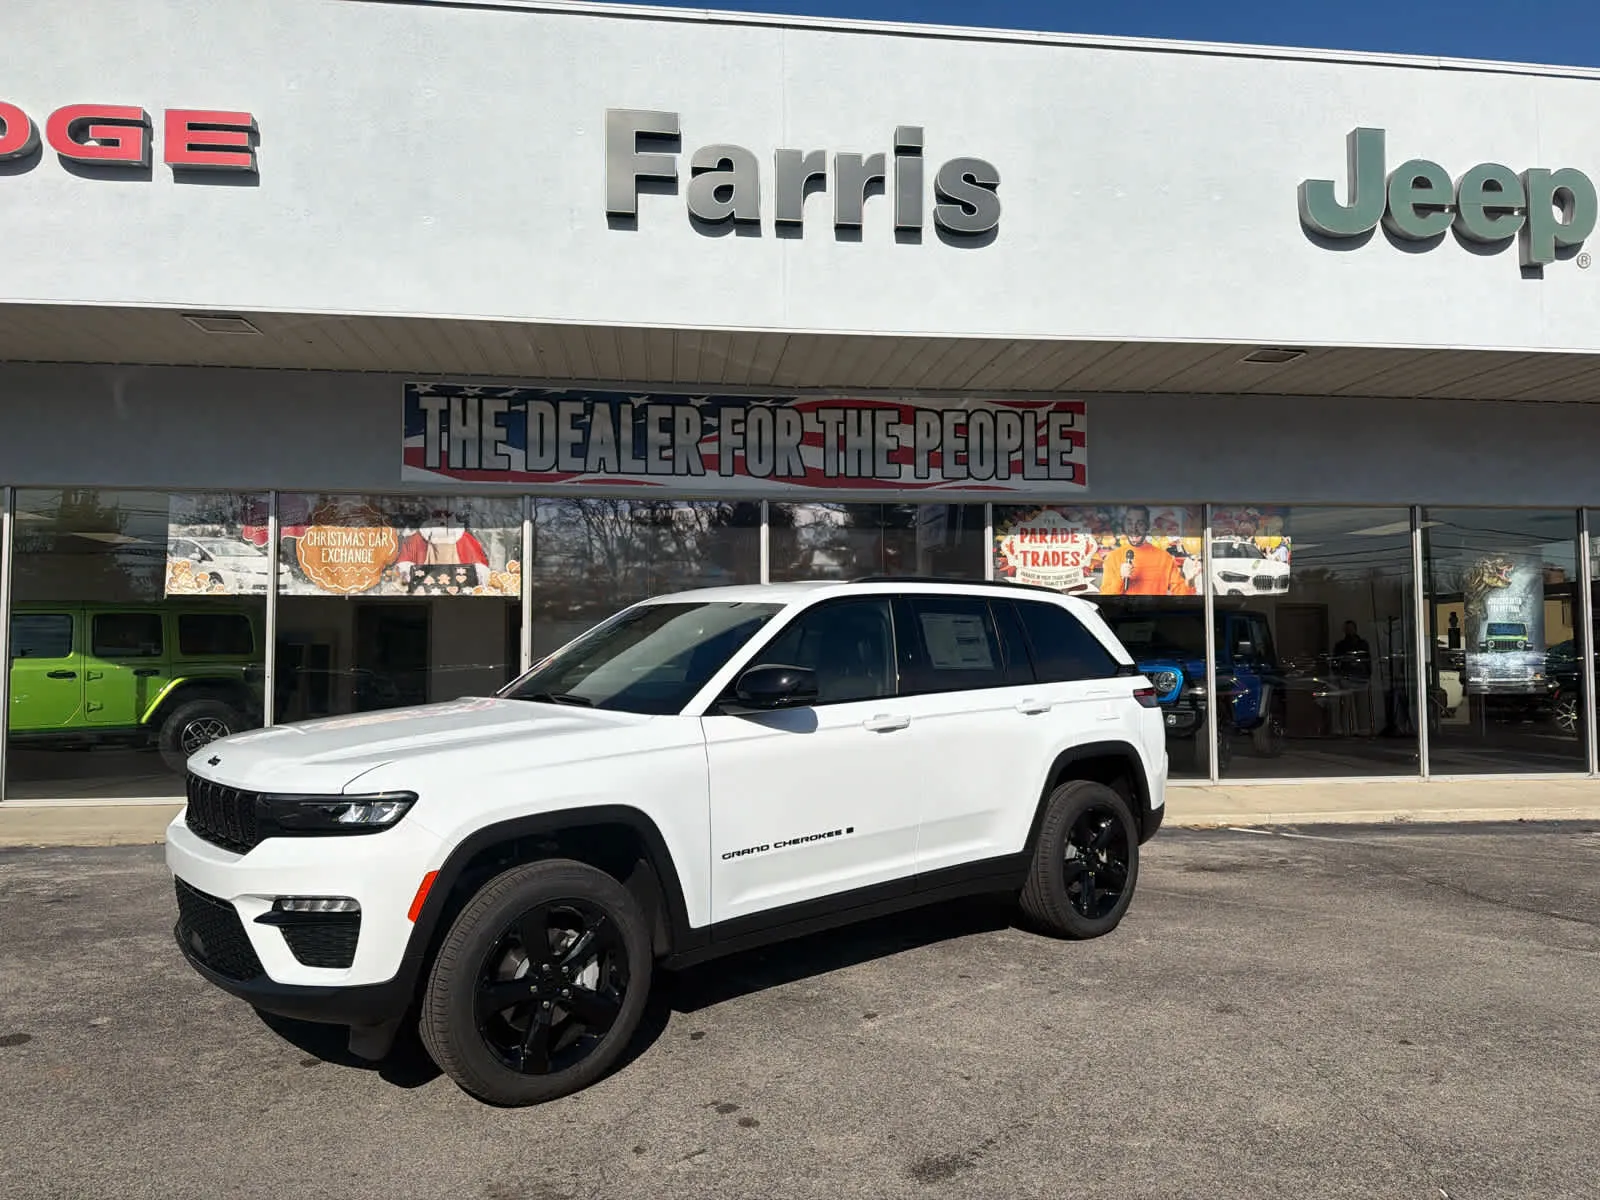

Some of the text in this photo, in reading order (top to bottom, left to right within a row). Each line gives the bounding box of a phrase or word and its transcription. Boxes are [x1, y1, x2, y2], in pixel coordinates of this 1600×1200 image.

[605, 107, 1001, 234] Farris
[1298, 126, 1599, 266] Jeep
[418, 394, 1076, 481] THE DEALER FOR THE PEOPLE
[307, 531, 389, 547] CHRISTMAS CAR
[1019, 527, 1081, 544] PARADE
[320, 547, 375, 564] EXCHANGE
[1019, 550, 1081, 567] TRADES
[721, 829, 842, 861] GRAND CHEROKEE
